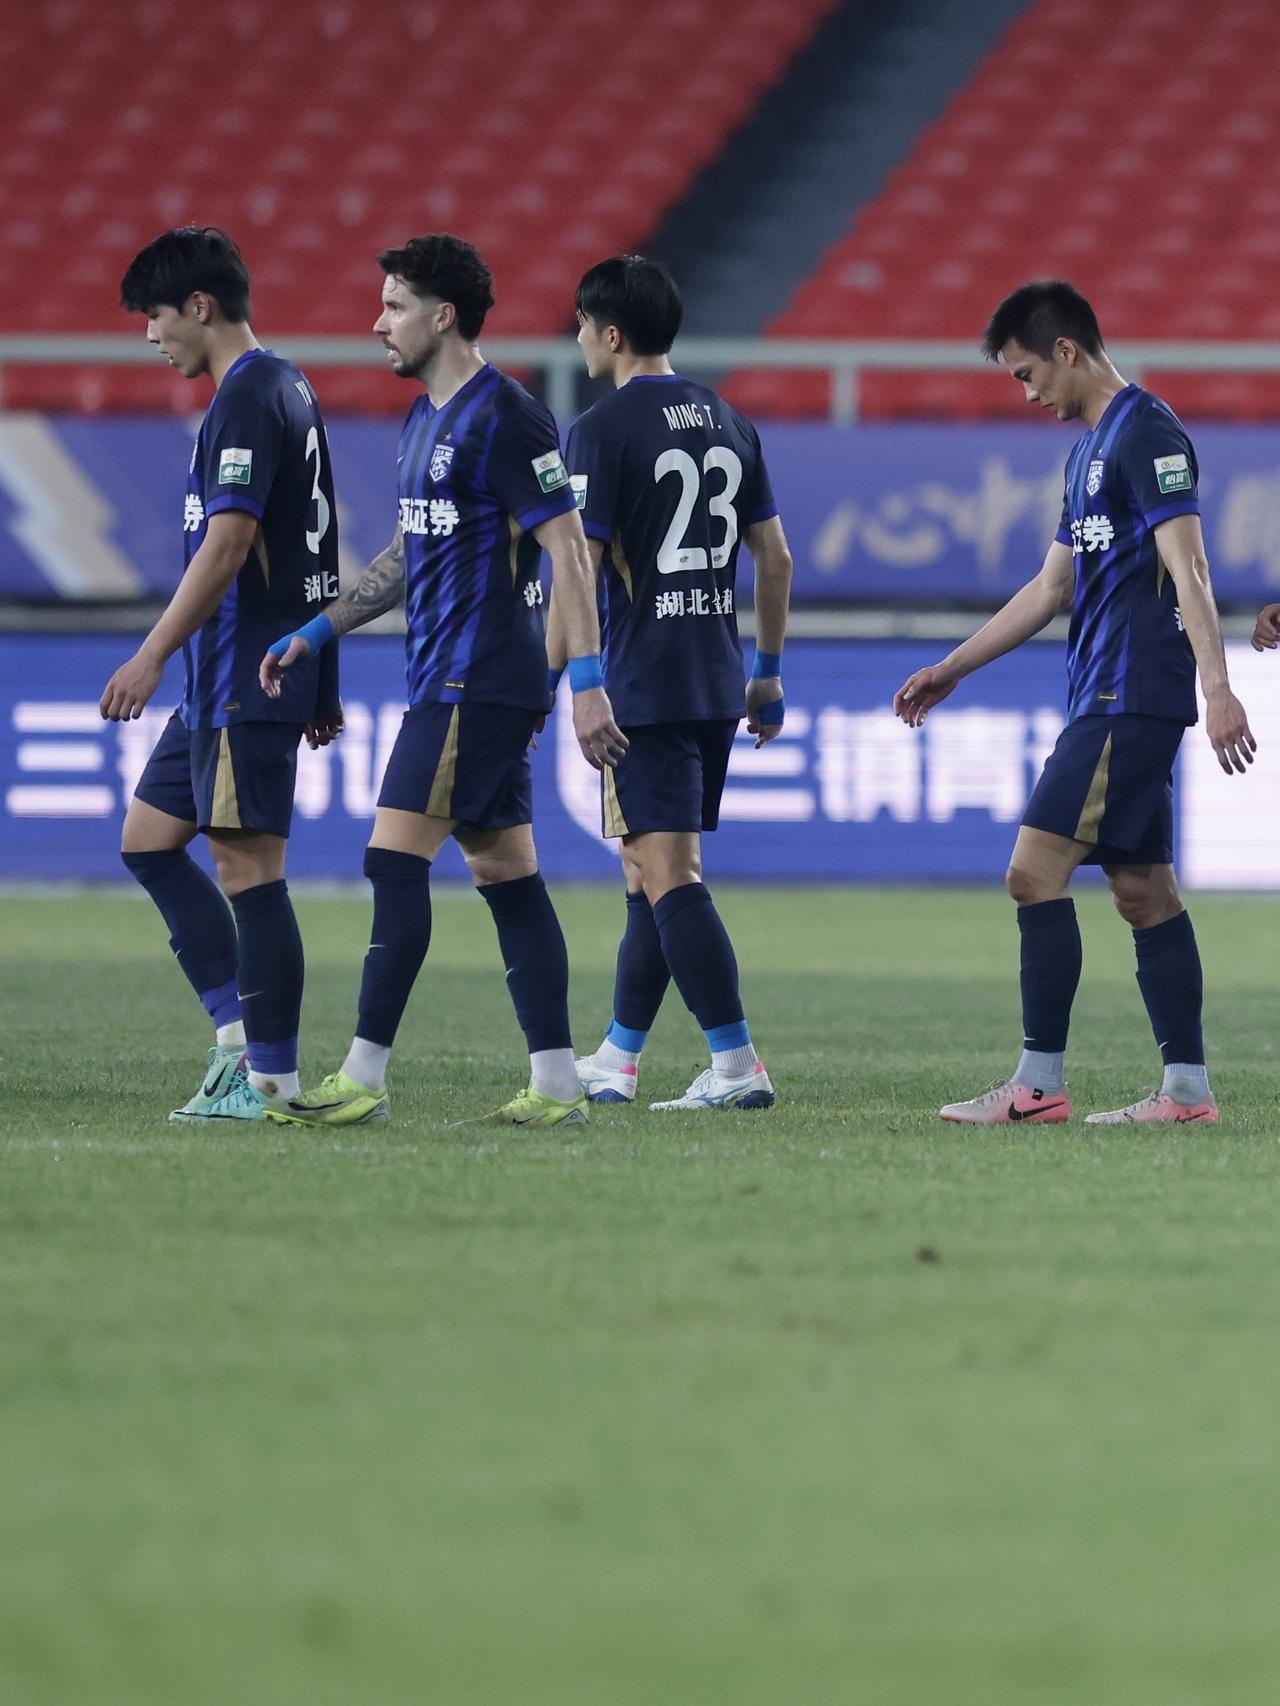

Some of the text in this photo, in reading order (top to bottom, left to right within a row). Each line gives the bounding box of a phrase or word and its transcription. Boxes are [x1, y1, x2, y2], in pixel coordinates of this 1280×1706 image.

[662, 403, 722, 431] MING T.
[305, 424, 330, 555] 3
[654, 446, 743, 575] 23
